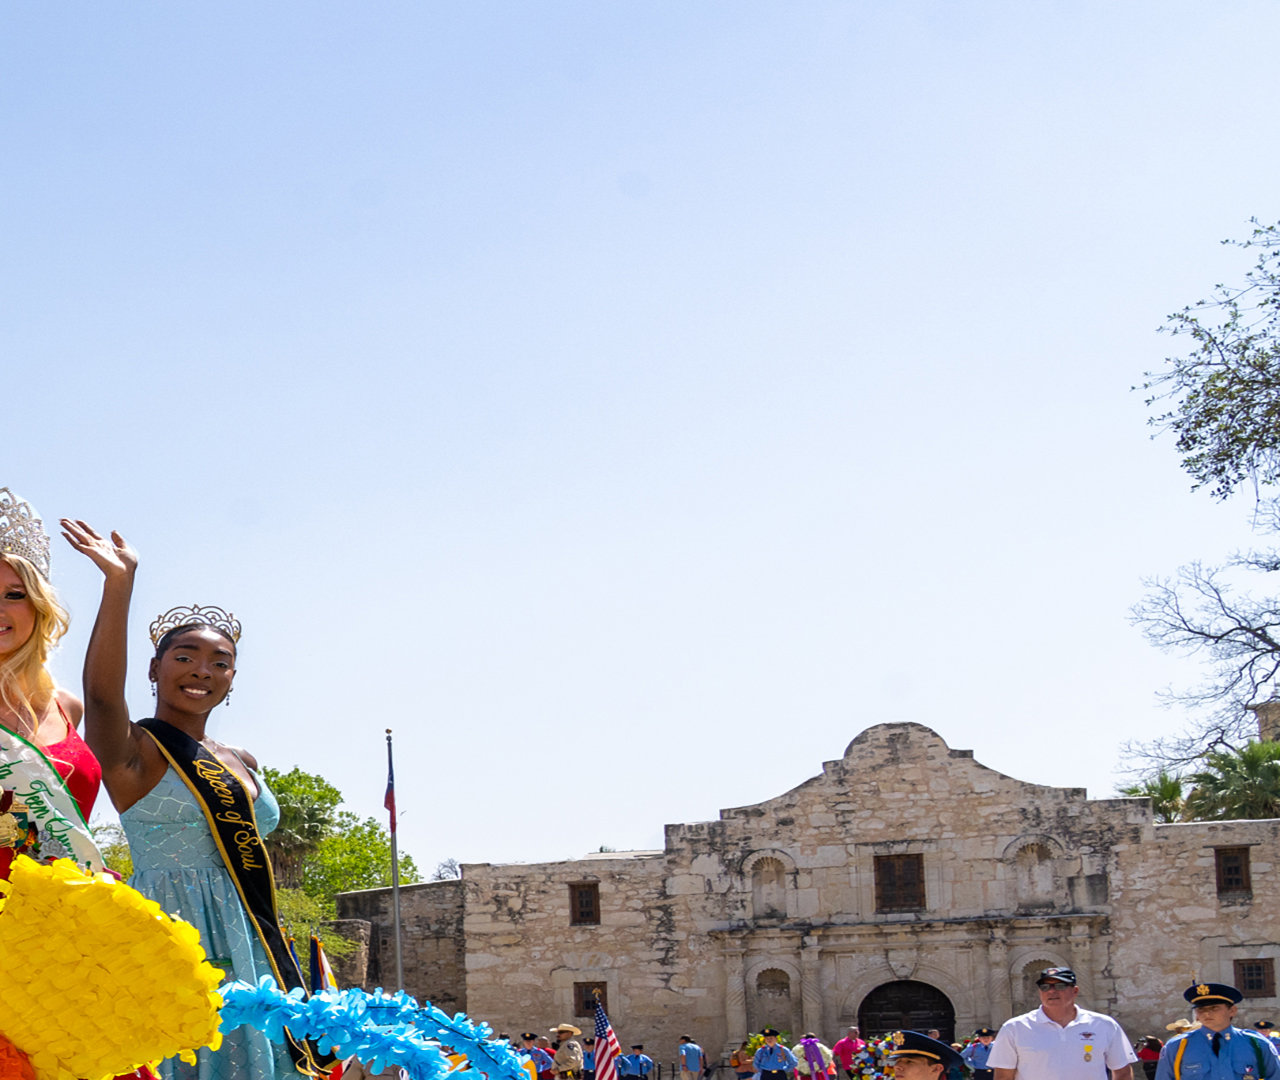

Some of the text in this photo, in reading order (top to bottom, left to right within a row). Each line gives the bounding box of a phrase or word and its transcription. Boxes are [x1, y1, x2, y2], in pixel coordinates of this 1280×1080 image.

[13, 780, 54, 819] Teen
[192, 759, 263, 871] Queen of Soul
